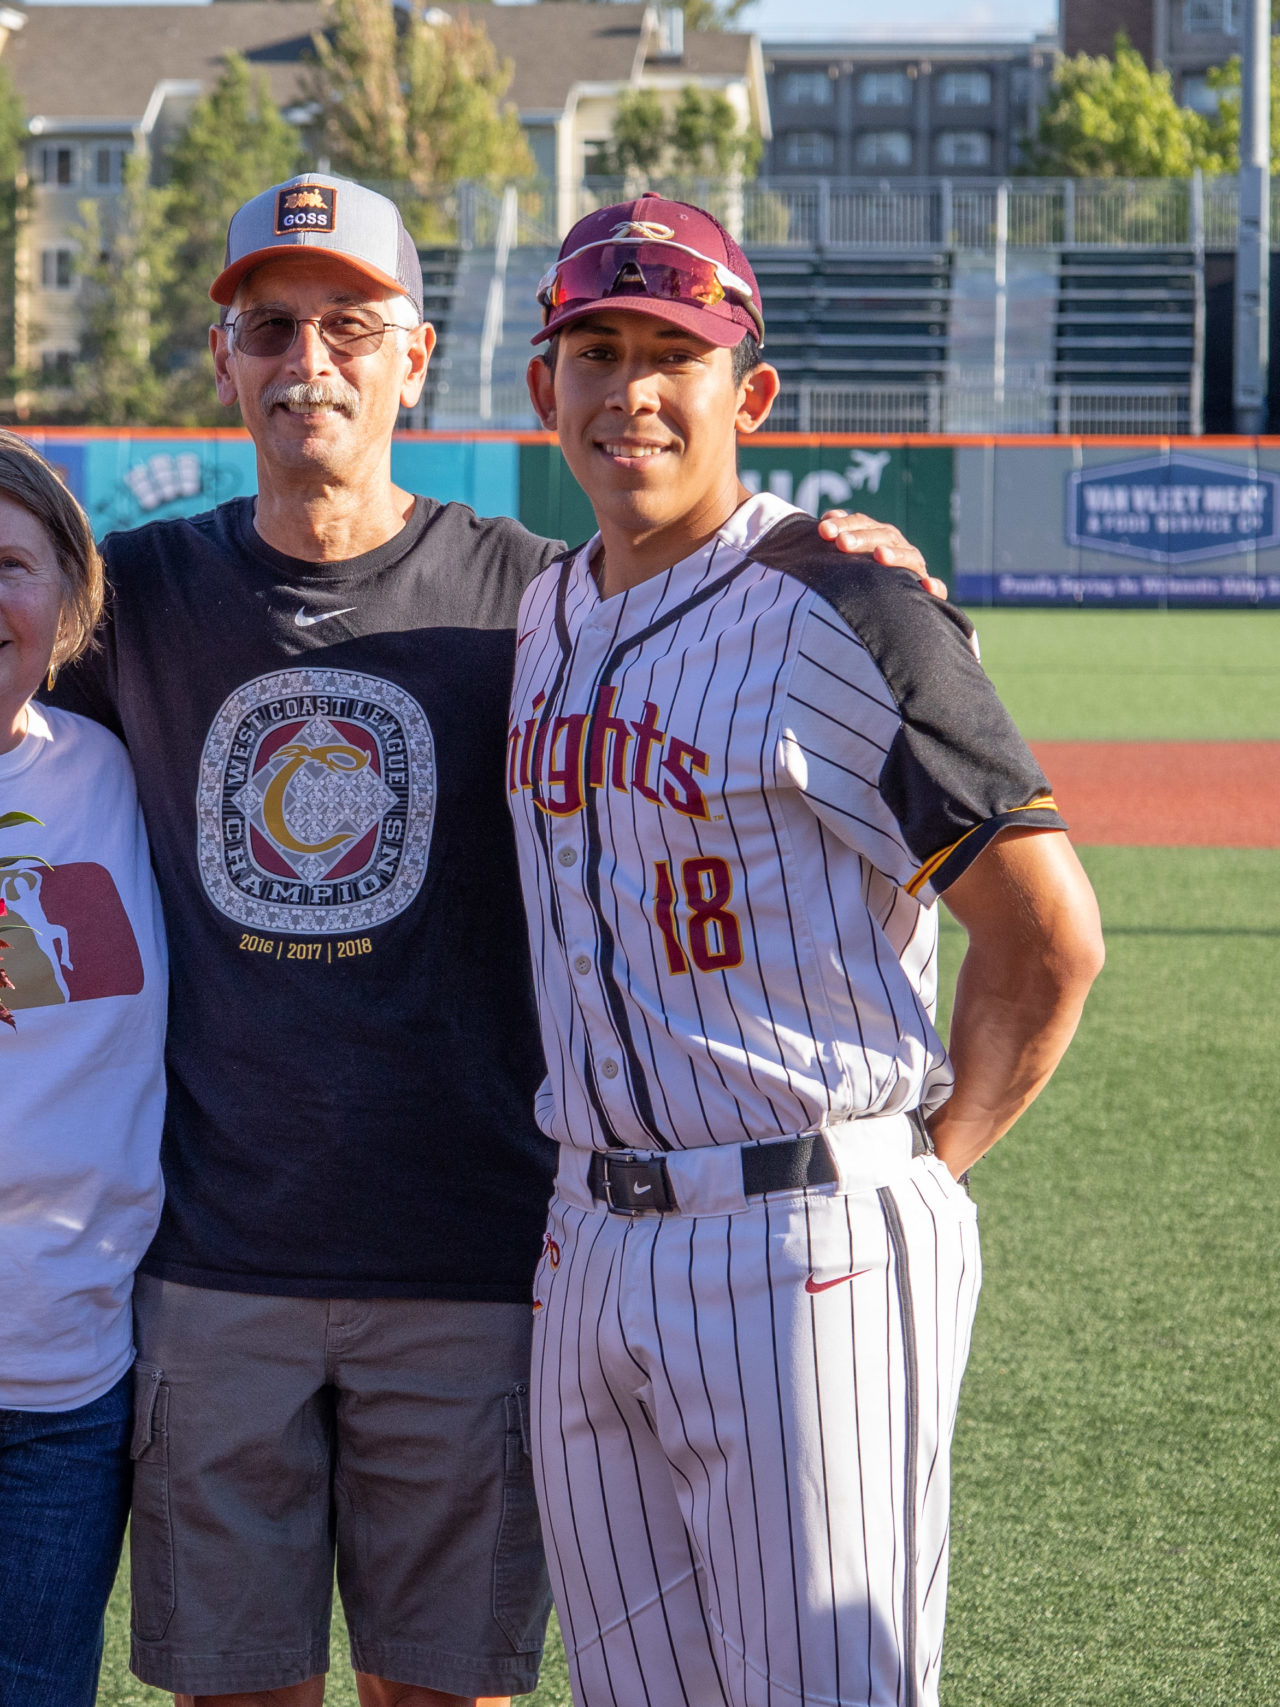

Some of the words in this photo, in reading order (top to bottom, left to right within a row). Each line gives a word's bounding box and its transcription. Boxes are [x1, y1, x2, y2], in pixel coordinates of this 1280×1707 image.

[283, 212, 328, 226] GOSS
[228, 712, 263, 785] WEST
[269, 696, 346, 721] COAST
[355, 700, 407, 785] LEAGUE
[508, 684, 710, 822] nights
[225, 818, 404, 904] CHAMPIONS
[239, 933, 274, 954] 2016
[287, 943, 322, 960] 2017
[337, 937, 373, 958] 2018
[651, 855, 745, 977] 18
